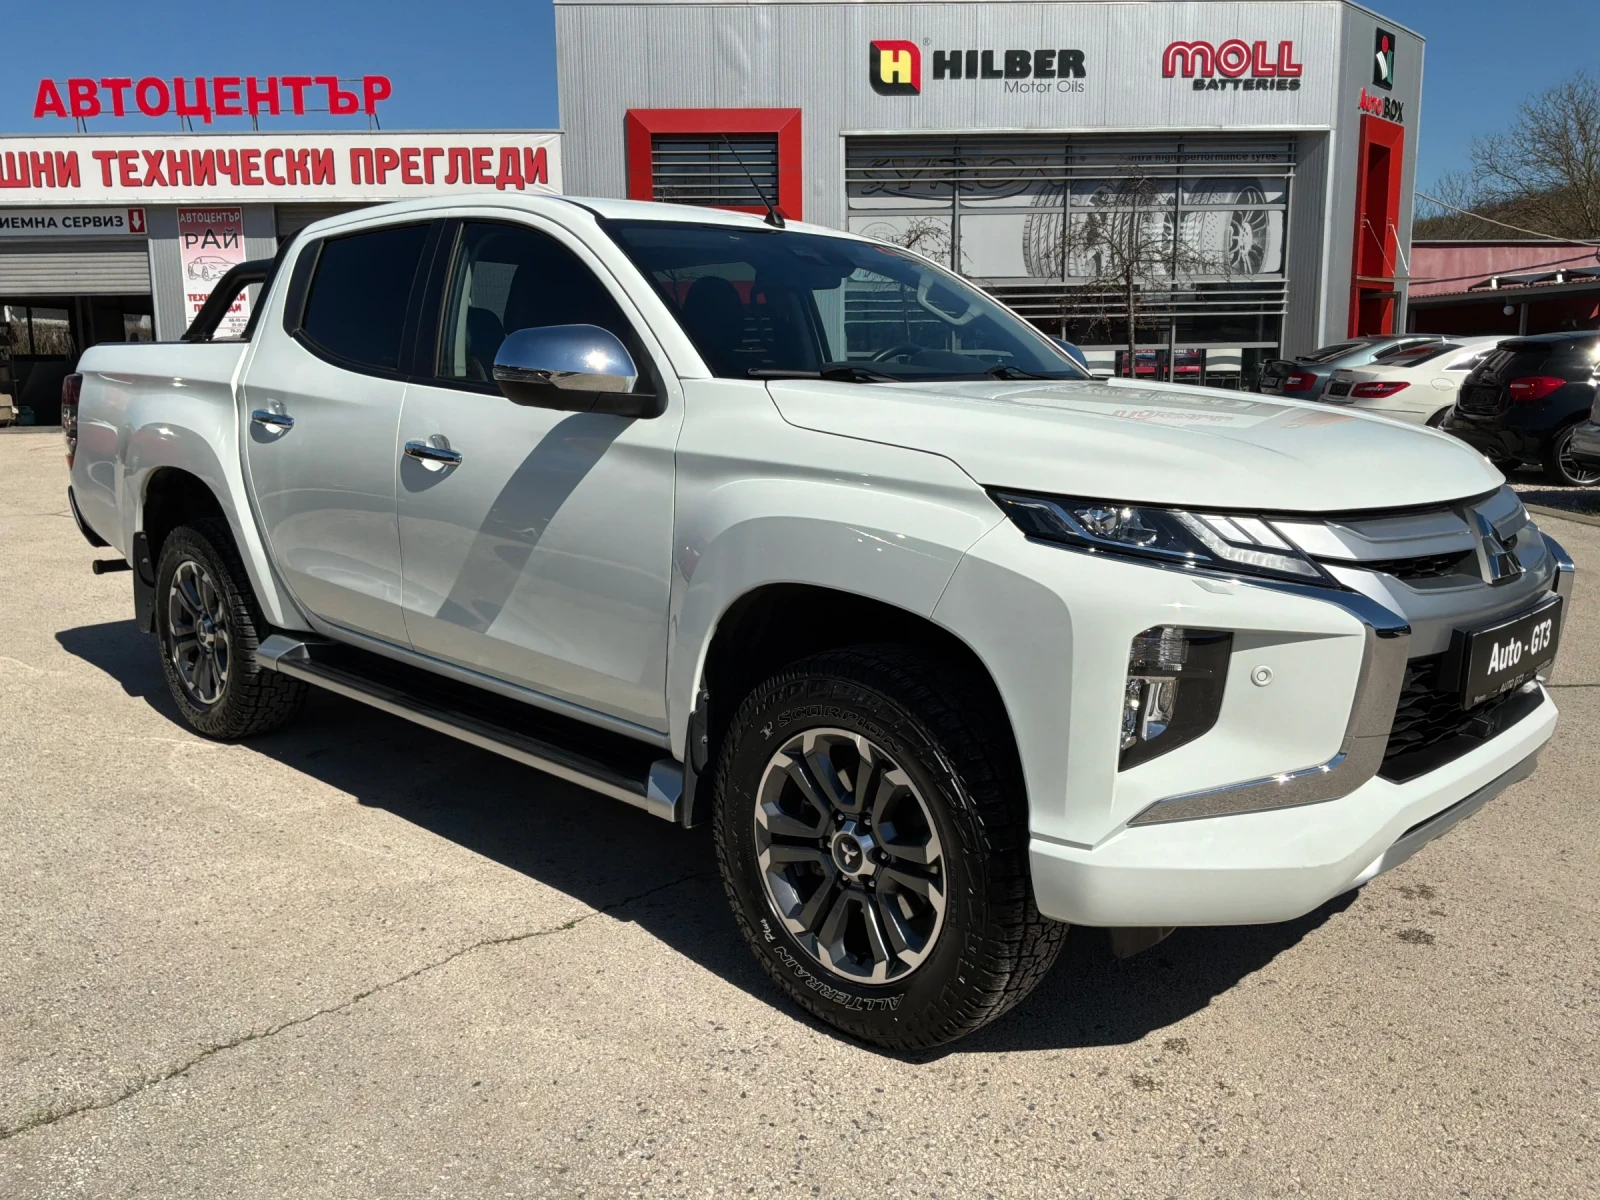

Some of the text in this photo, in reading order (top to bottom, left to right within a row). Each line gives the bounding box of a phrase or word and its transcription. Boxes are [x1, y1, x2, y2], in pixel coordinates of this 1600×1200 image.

[932, 49, 1087, 80] HILBER
[33, 75, 392, 124] АВТОЦЕНТЪР
[1004, 80, 1085, 93] Motor Oils
[1192, 78, 1301, 91] BATTERIES
[93, 148, 335, 188] ТЕХНИЧЕСКИ
[350, 146, 548, 191] ПРЕГЛЕДИ
[62, 216, 124, 228] СЕРВИЗ
[180, 212, 240, 224] АВТОЦЕНТЪР
[184, 228, 239, 249] РАЙ
[1487, 637, 1523, 676] Auto
[1530, 618, 1552, 656] GT3
[777, 704, 904, 754] SCORPION
[773, 945, 906, 1011] ALLTERRAIN
